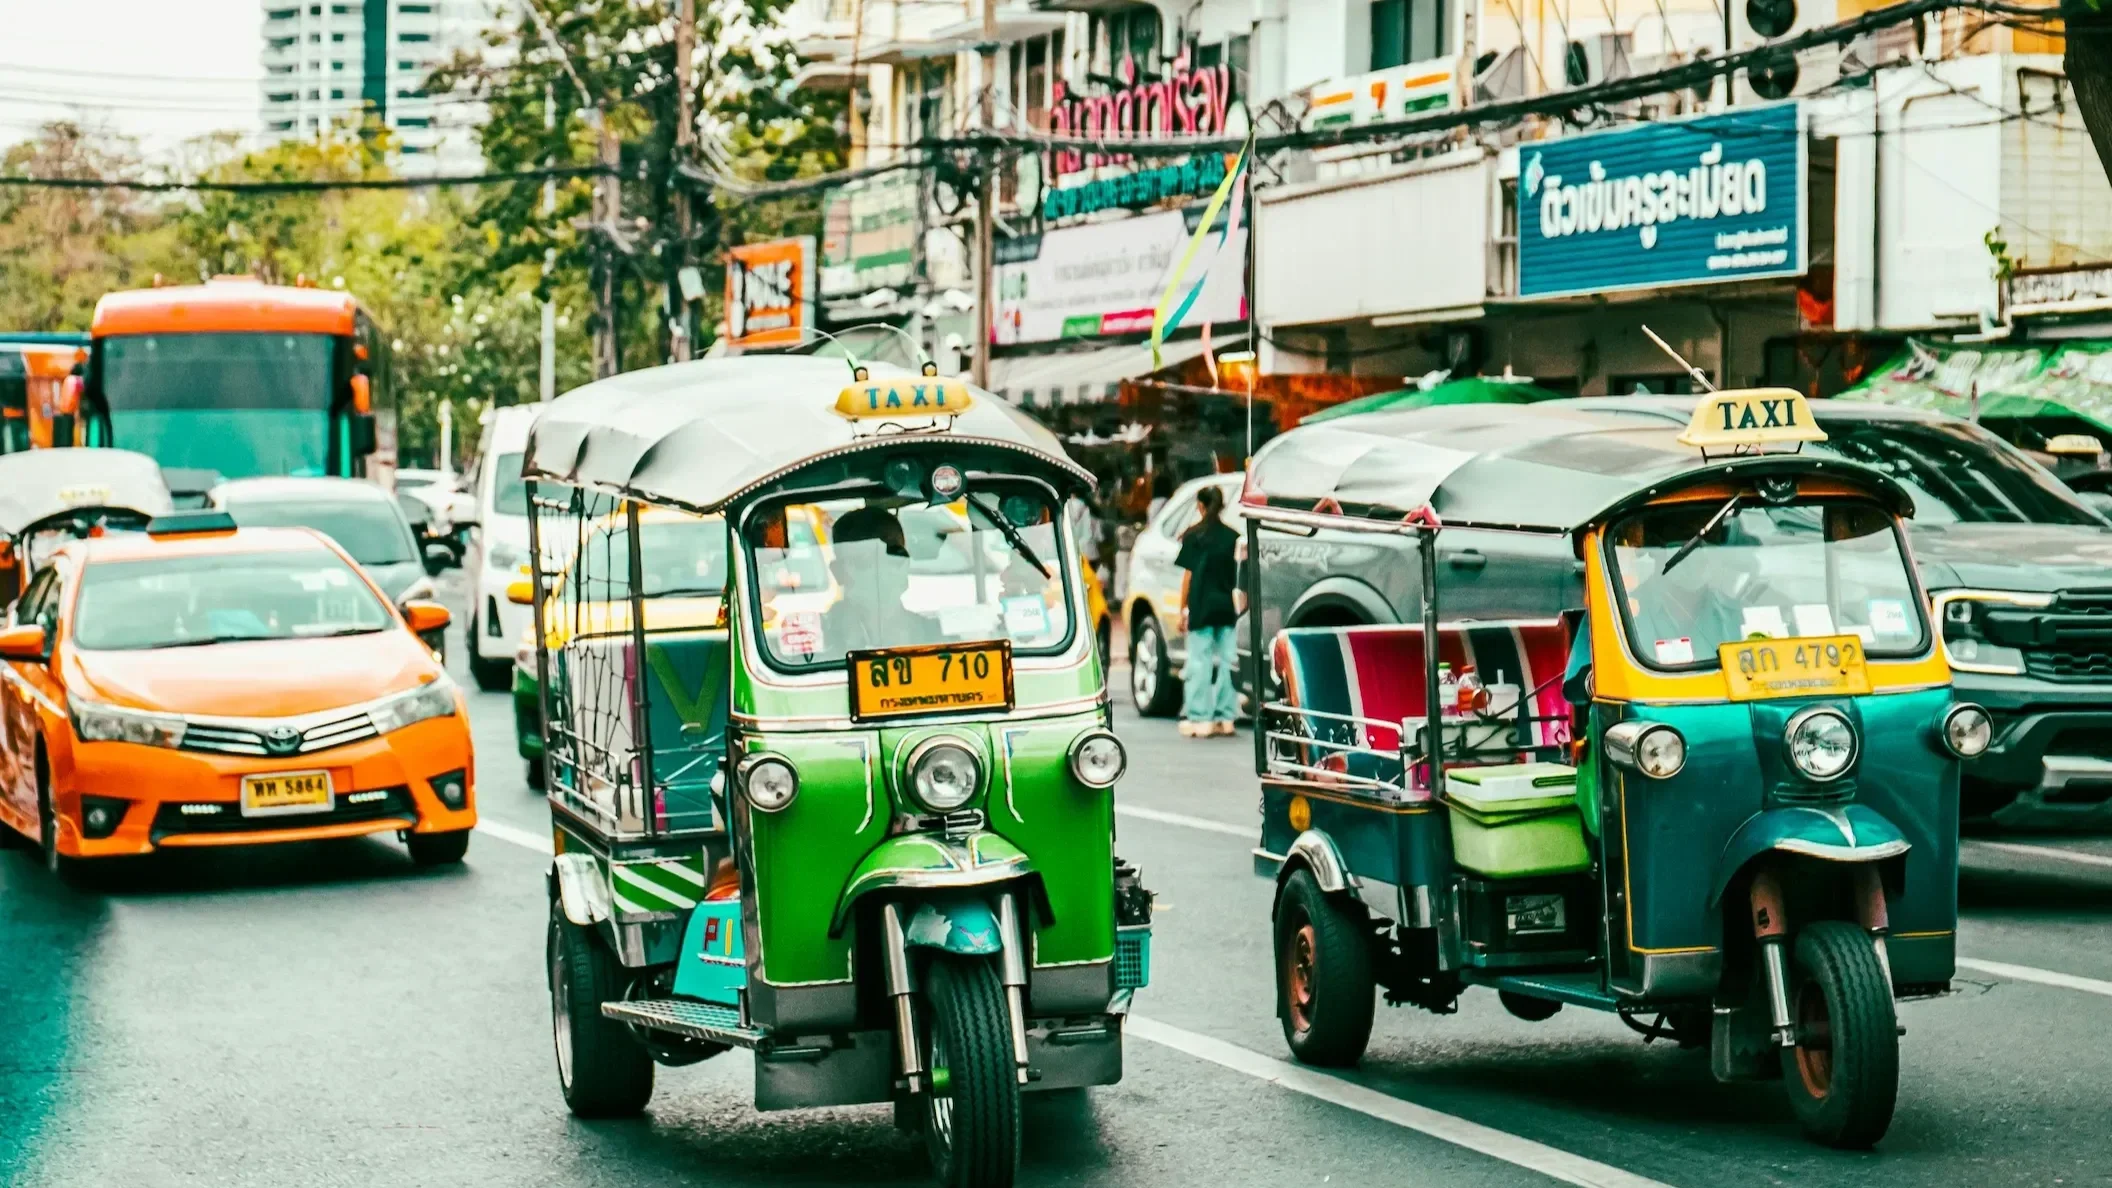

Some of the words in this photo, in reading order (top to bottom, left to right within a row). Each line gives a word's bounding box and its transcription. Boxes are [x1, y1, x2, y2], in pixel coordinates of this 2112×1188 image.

[864, 384, 946, 409] TAXI
[1717, 398, 1797, 430] TAXI
[937, 651, 989, 683] 710
[1795, 643, 1861, 669] 4792
